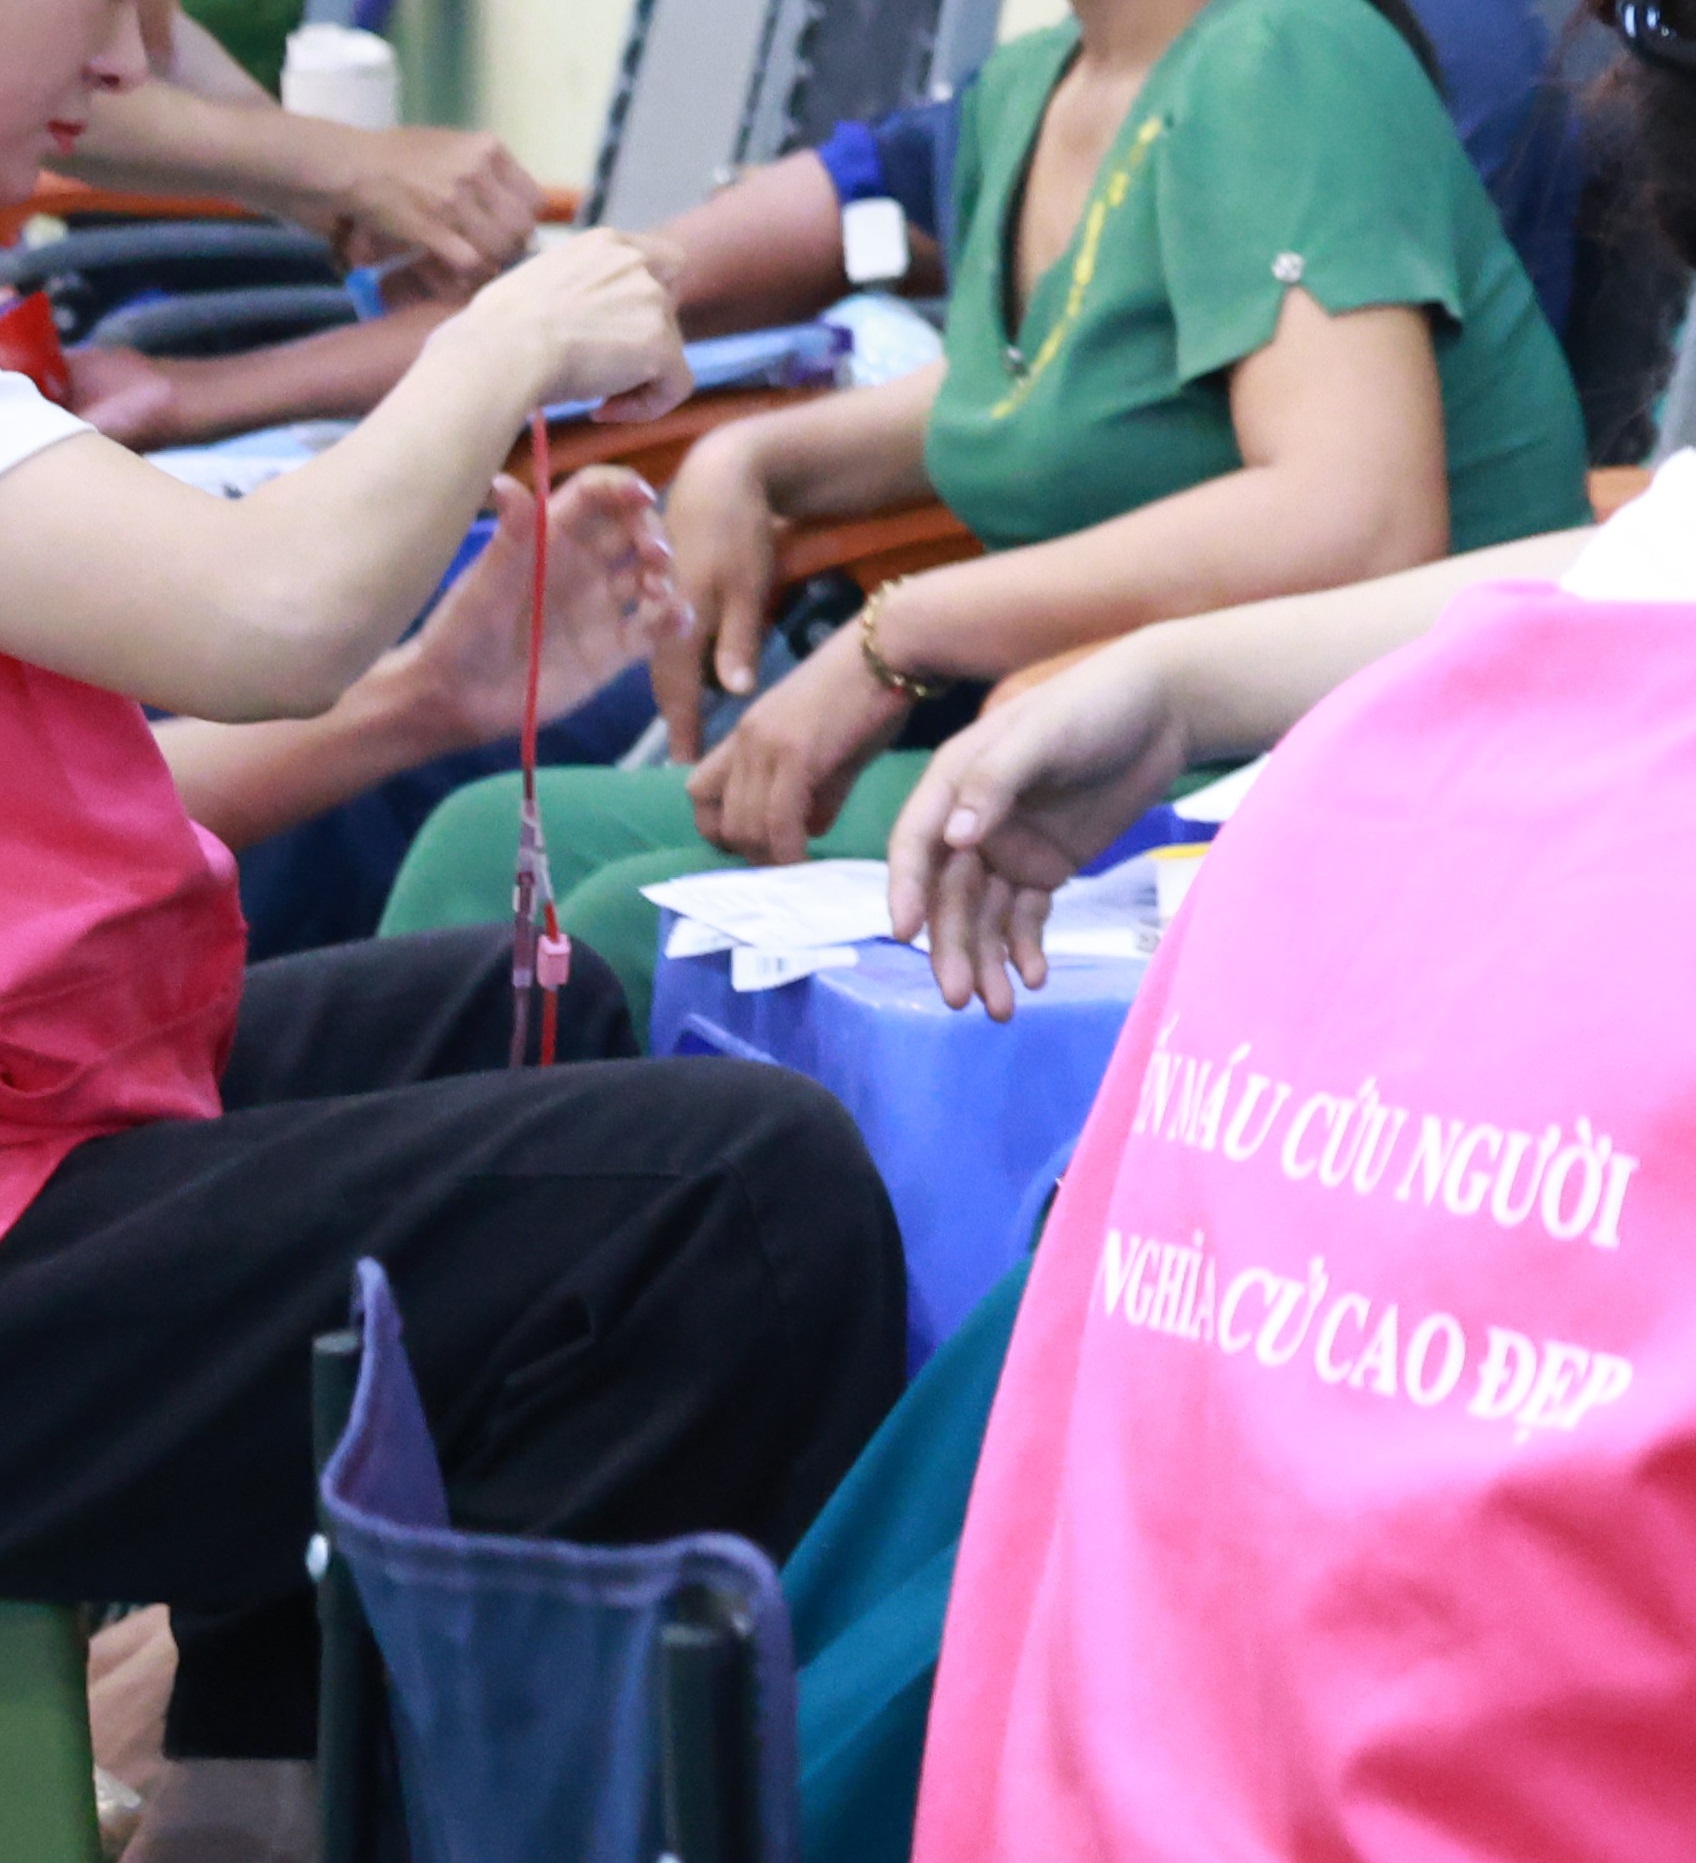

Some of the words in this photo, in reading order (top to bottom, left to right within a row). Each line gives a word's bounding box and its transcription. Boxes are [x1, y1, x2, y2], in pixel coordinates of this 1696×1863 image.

[1166, 1040, 1293, 1162] MÁU
[1281, 1075, 1410, 1197] CỨU
[1393, 1114, 1641, 1252] NGƯỜI
[1314, 1291, 1466, 1408] CAO
[1465, 1323, 1635, 1446] ĐẸP
